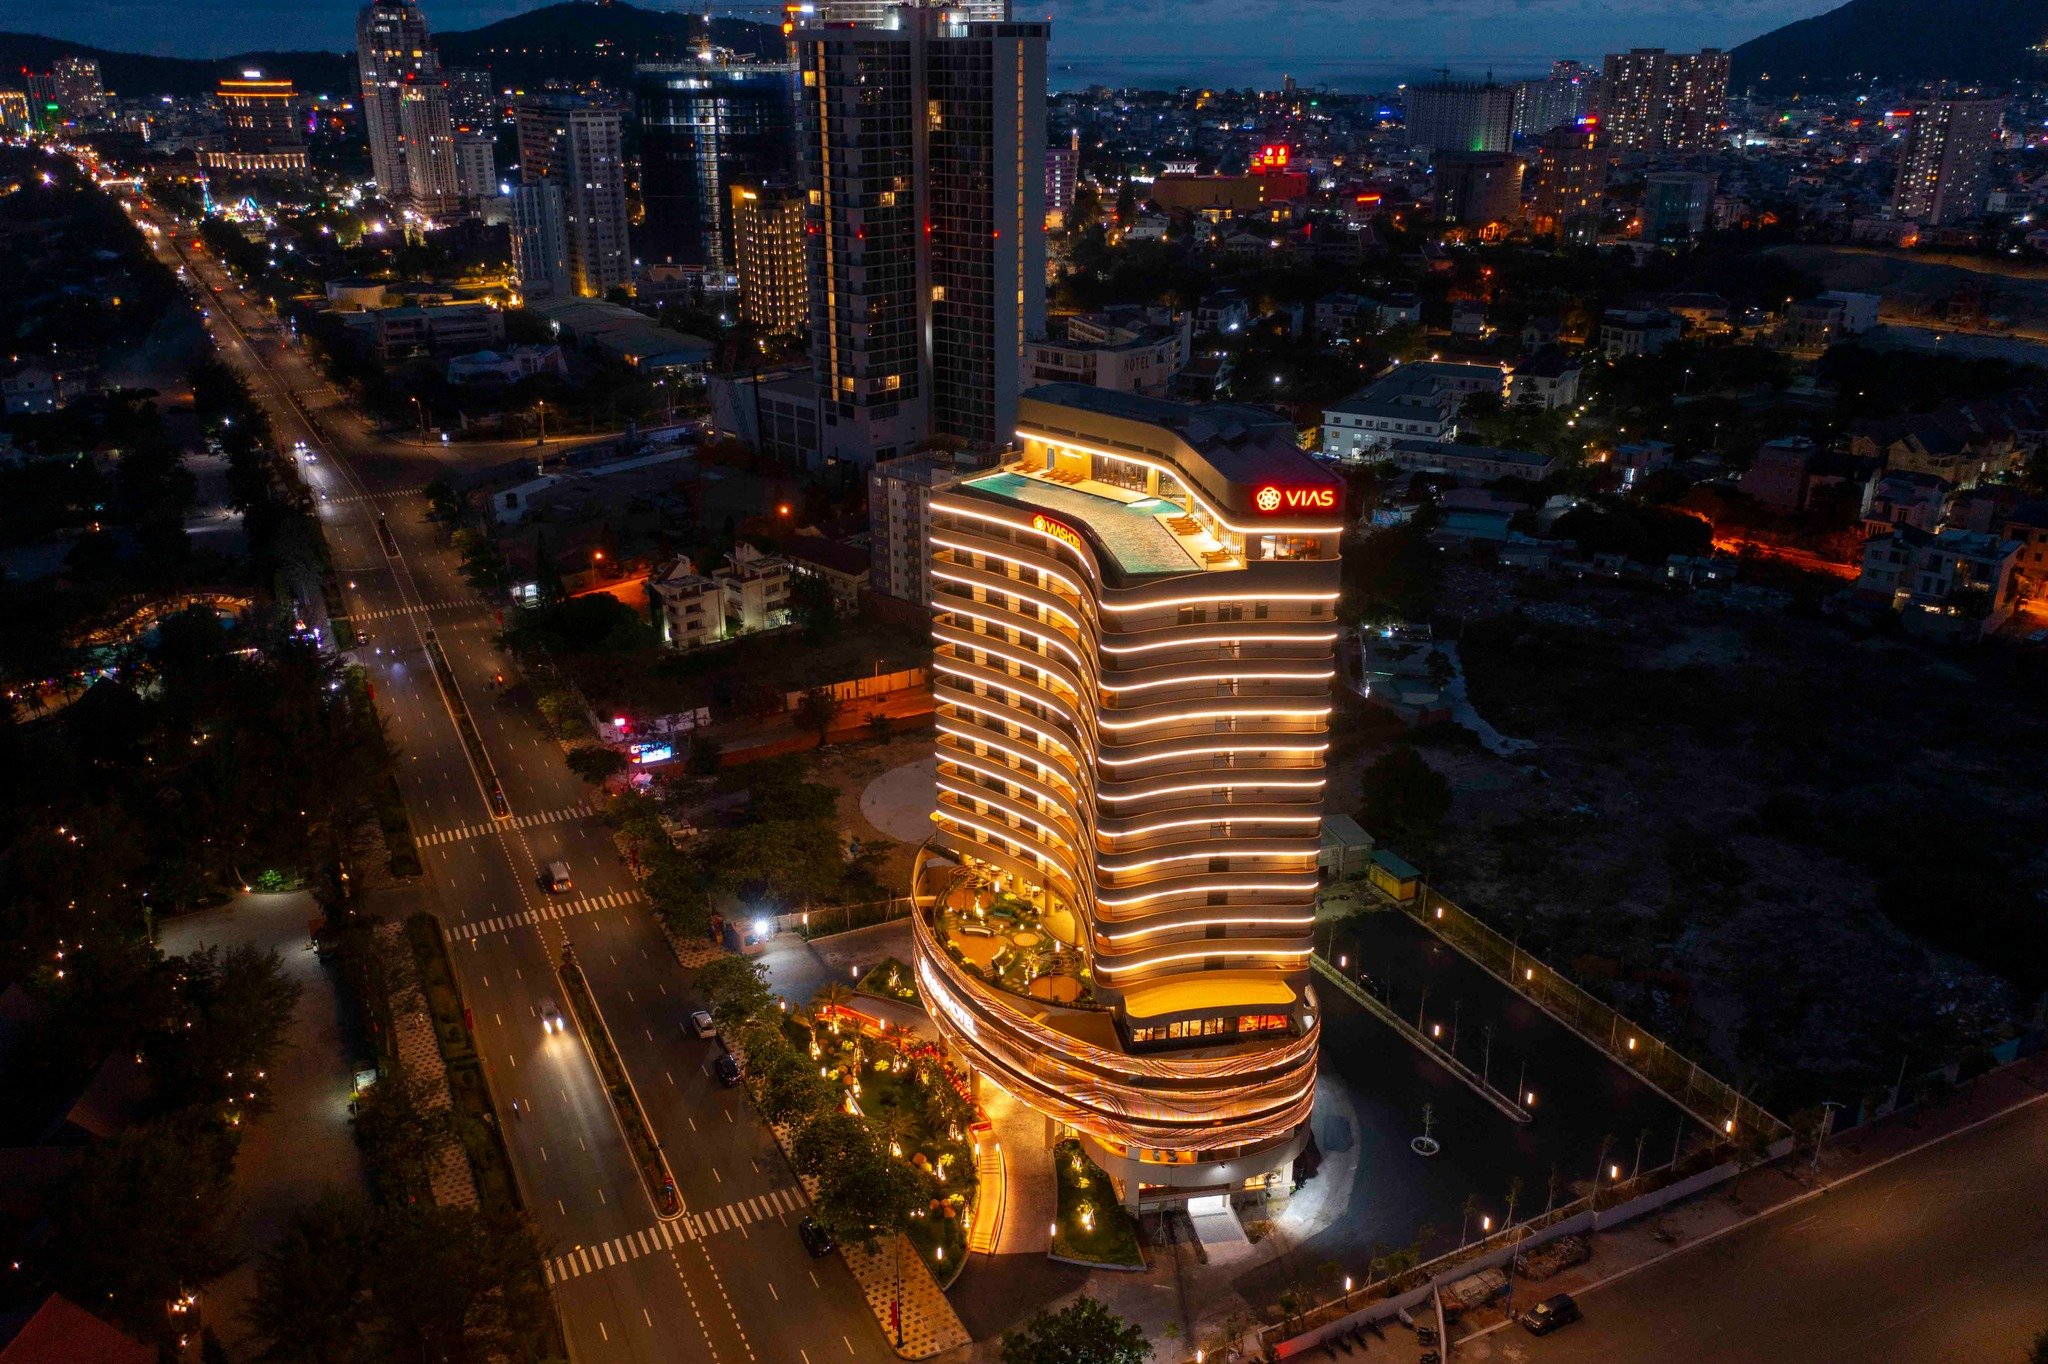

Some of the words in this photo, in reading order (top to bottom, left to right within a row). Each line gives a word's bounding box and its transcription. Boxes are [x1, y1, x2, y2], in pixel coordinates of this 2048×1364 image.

[1124, 355, 1150, 373] HOTEL
[1286, 490, 1334, 507] VIAS
[1046, 520, 1067, 540] VIAS
